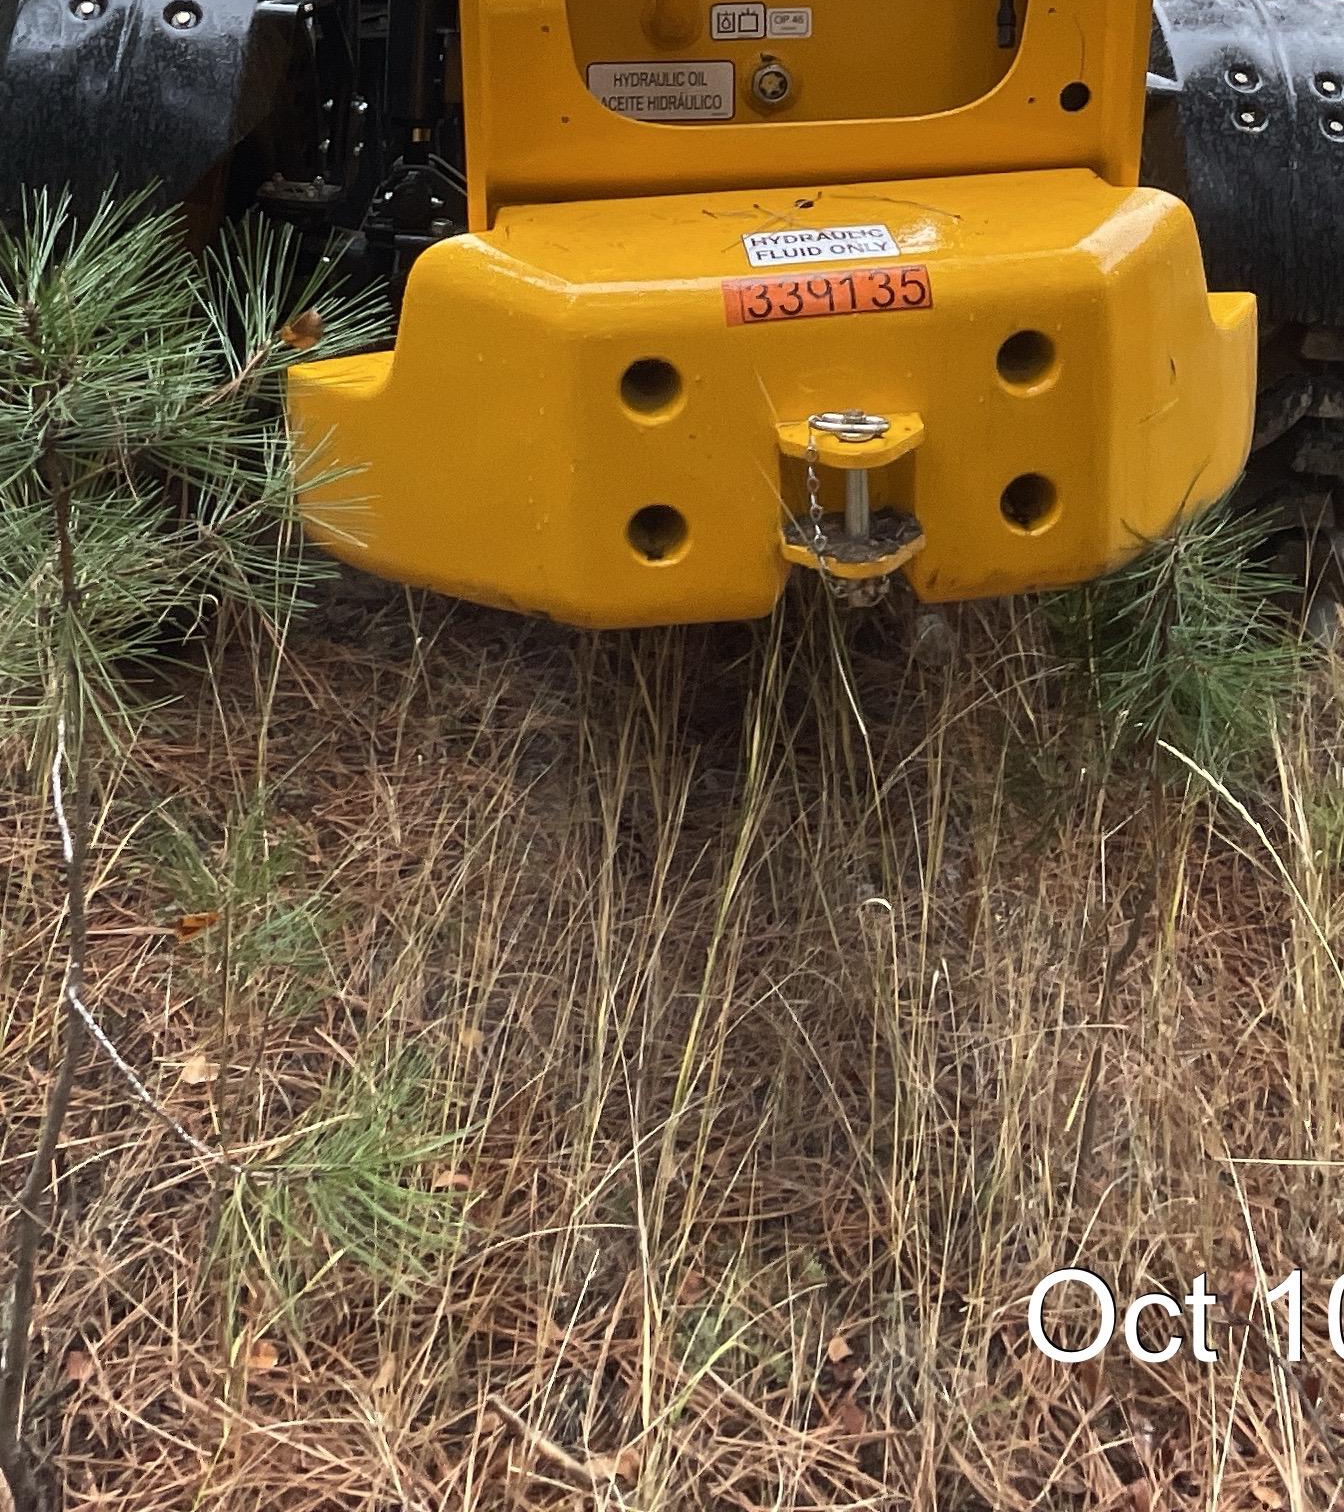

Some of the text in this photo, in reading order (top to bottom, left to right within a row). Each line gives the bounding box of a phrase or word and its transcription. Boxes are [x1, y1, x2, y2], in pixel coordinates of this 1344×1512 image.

[613, 71, 708, 87] HYDRAULIC OIL
[601, 92, 723, 111] ACEITE HIDRÁULICO
[751, 227, 885, 248] HYDRAULIC
[757, 240, 890, 261] FLUID ONLY
[746, 265, 927, 319] 339135
